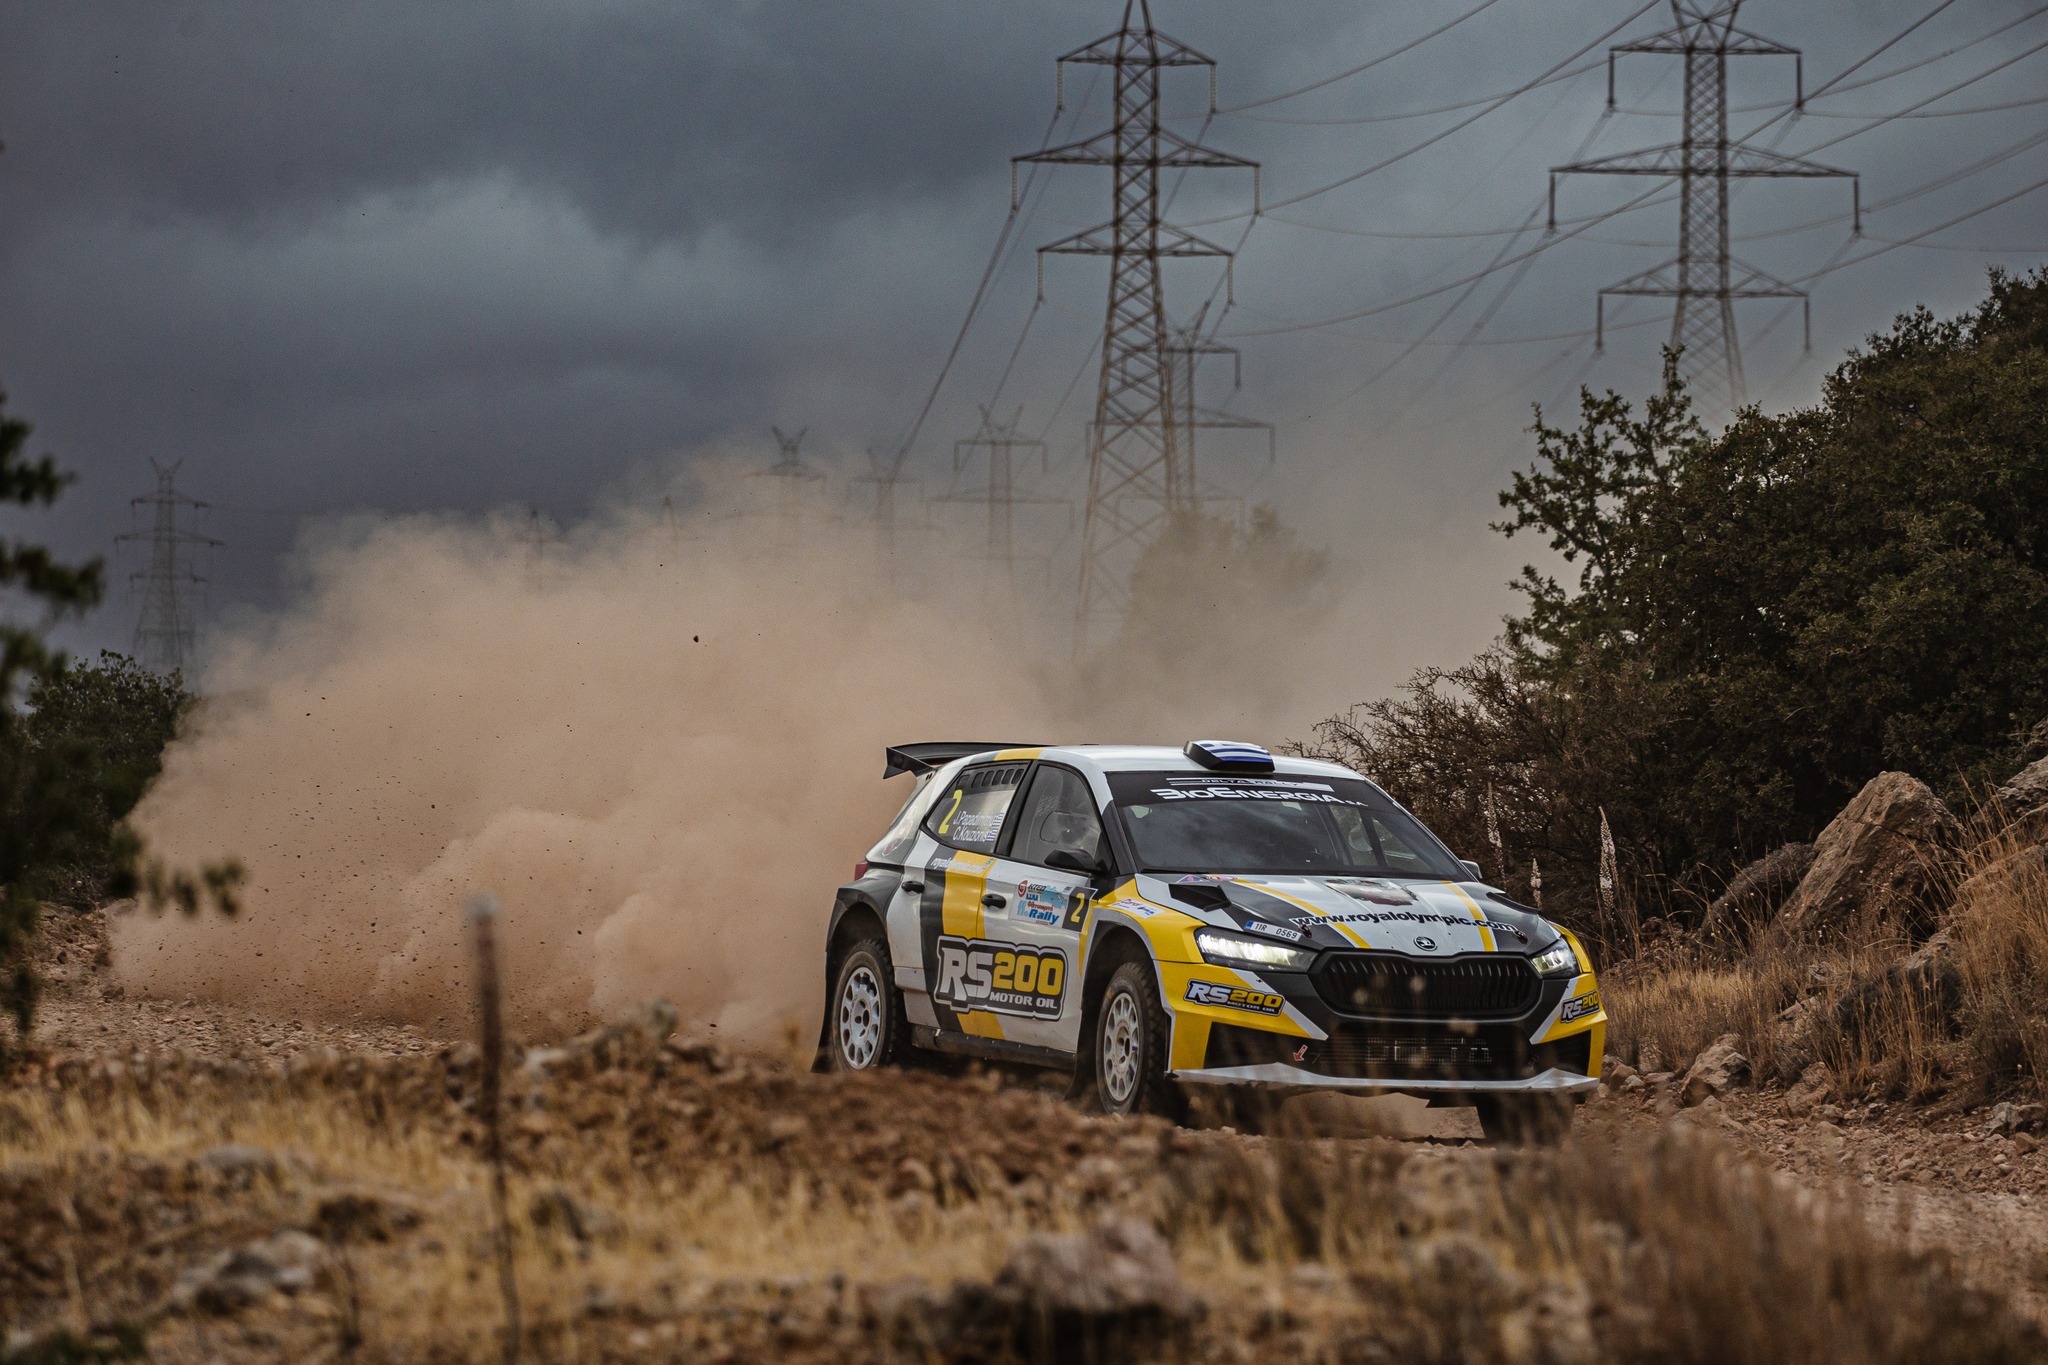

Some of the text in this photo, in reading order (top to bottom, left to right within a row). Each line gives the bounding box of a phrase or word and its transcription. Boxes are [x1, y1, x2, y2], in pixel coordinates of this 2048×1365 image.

[938, 789, 963, 834] 2
[1029, 909, 1059, 925] Rally
[1070, 892, 1085, 923] 2
[1254, 922, 1298, 939] 11R 0569
[1290, 911, 1518, 932] www.royalolympic.com
[940, 947, 1064, 1001] RS200
[989, 991, 1057, 1009] MOTOR OIL
[1188, 982, 1282, 1008] RS200
[1562, 994, 1599, 1019] RS200
